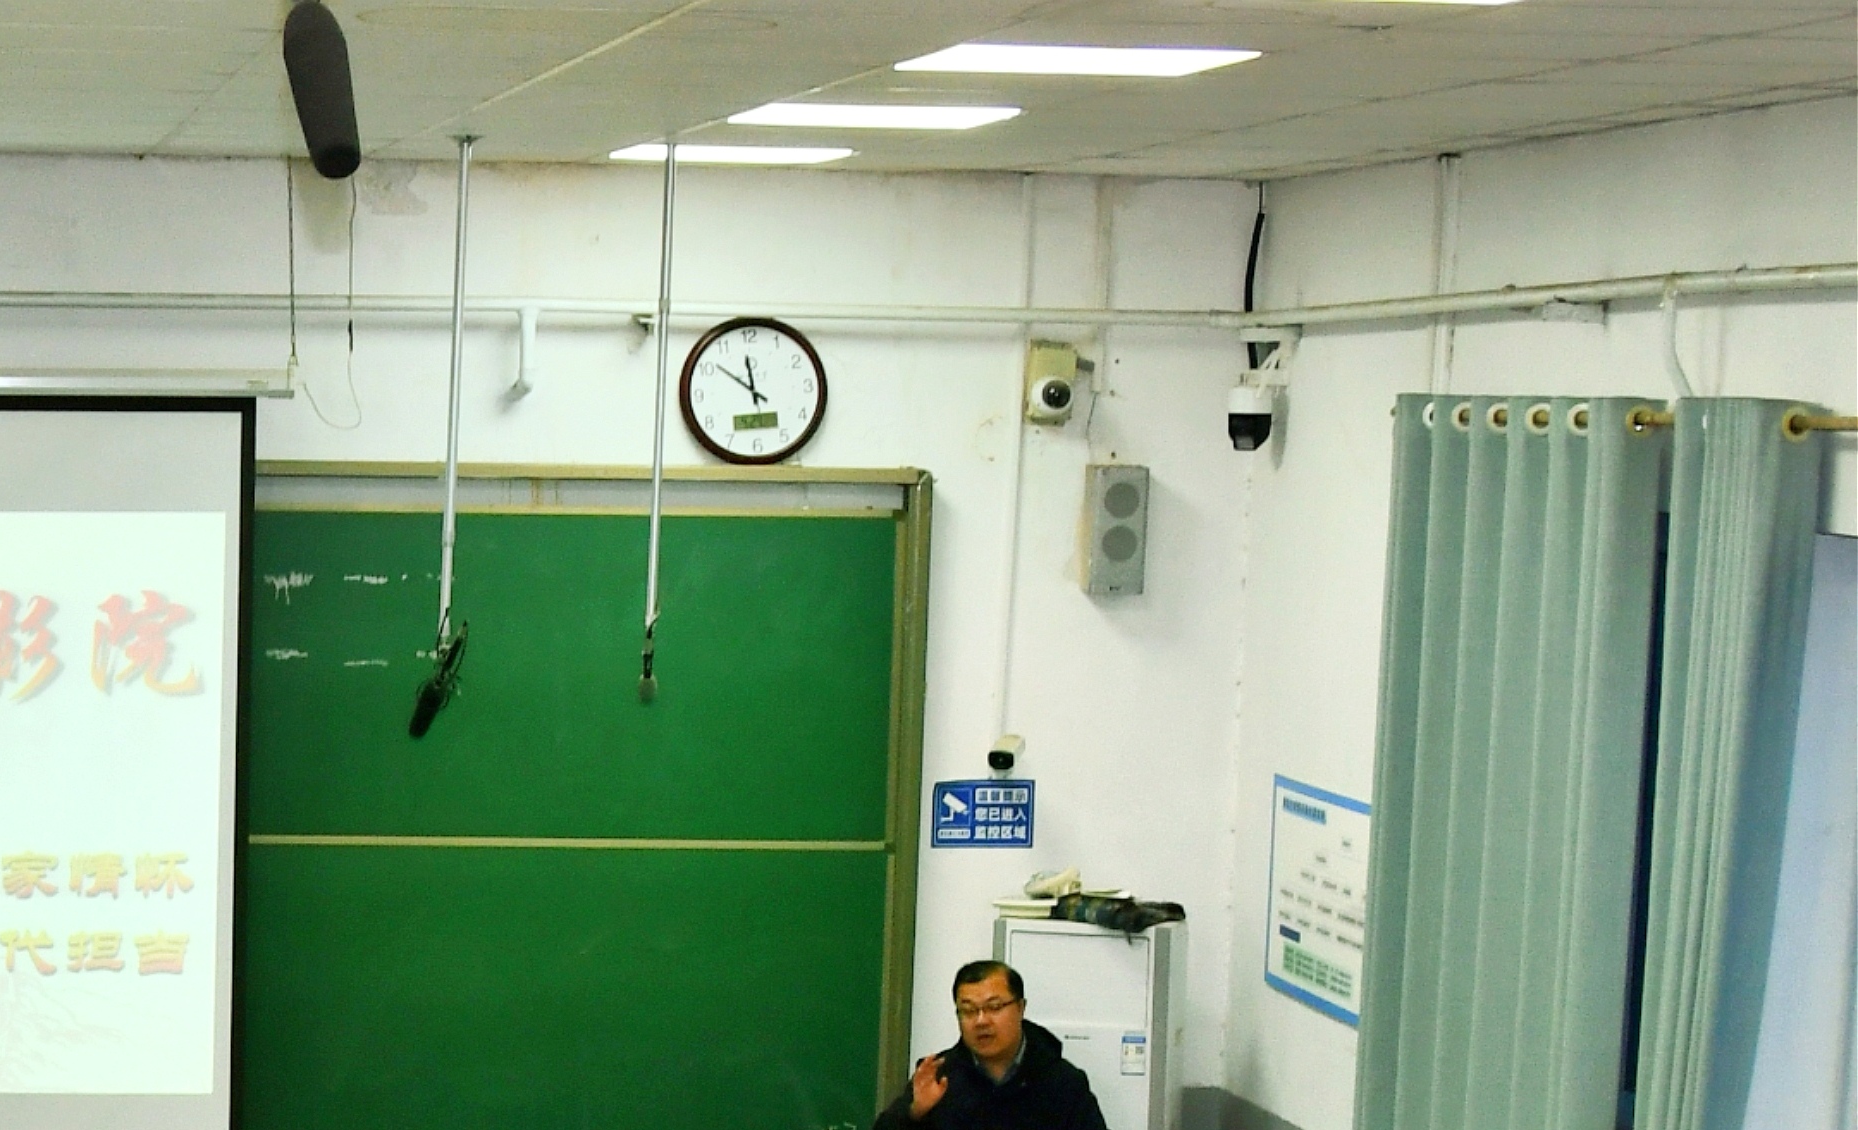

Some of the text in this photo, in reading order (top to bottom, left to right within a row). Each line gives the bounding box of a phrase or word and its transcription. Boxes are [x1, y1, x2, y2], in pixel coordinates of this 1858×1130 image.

[742, 329, 757, 343] 12
[774, 335, 780, 349] 1
[717, 340, 729, 354] 11
[698, 361, 715, 376] 10
[791, 354, 802, 369] 2
[803, 379, 814, 393] 3
[694, 388, 704, 403] 9
[798, 407, 807, 420] 4
[704, 415, 714, 430] 8
[725, 434, 734, 448] 7
[779, 428, 790, 442] 5
[753, 438, 763, 453] 6
[974, 807, 1027, 821] 您已进入
[974, 825, 1026, 840] 监控区域
